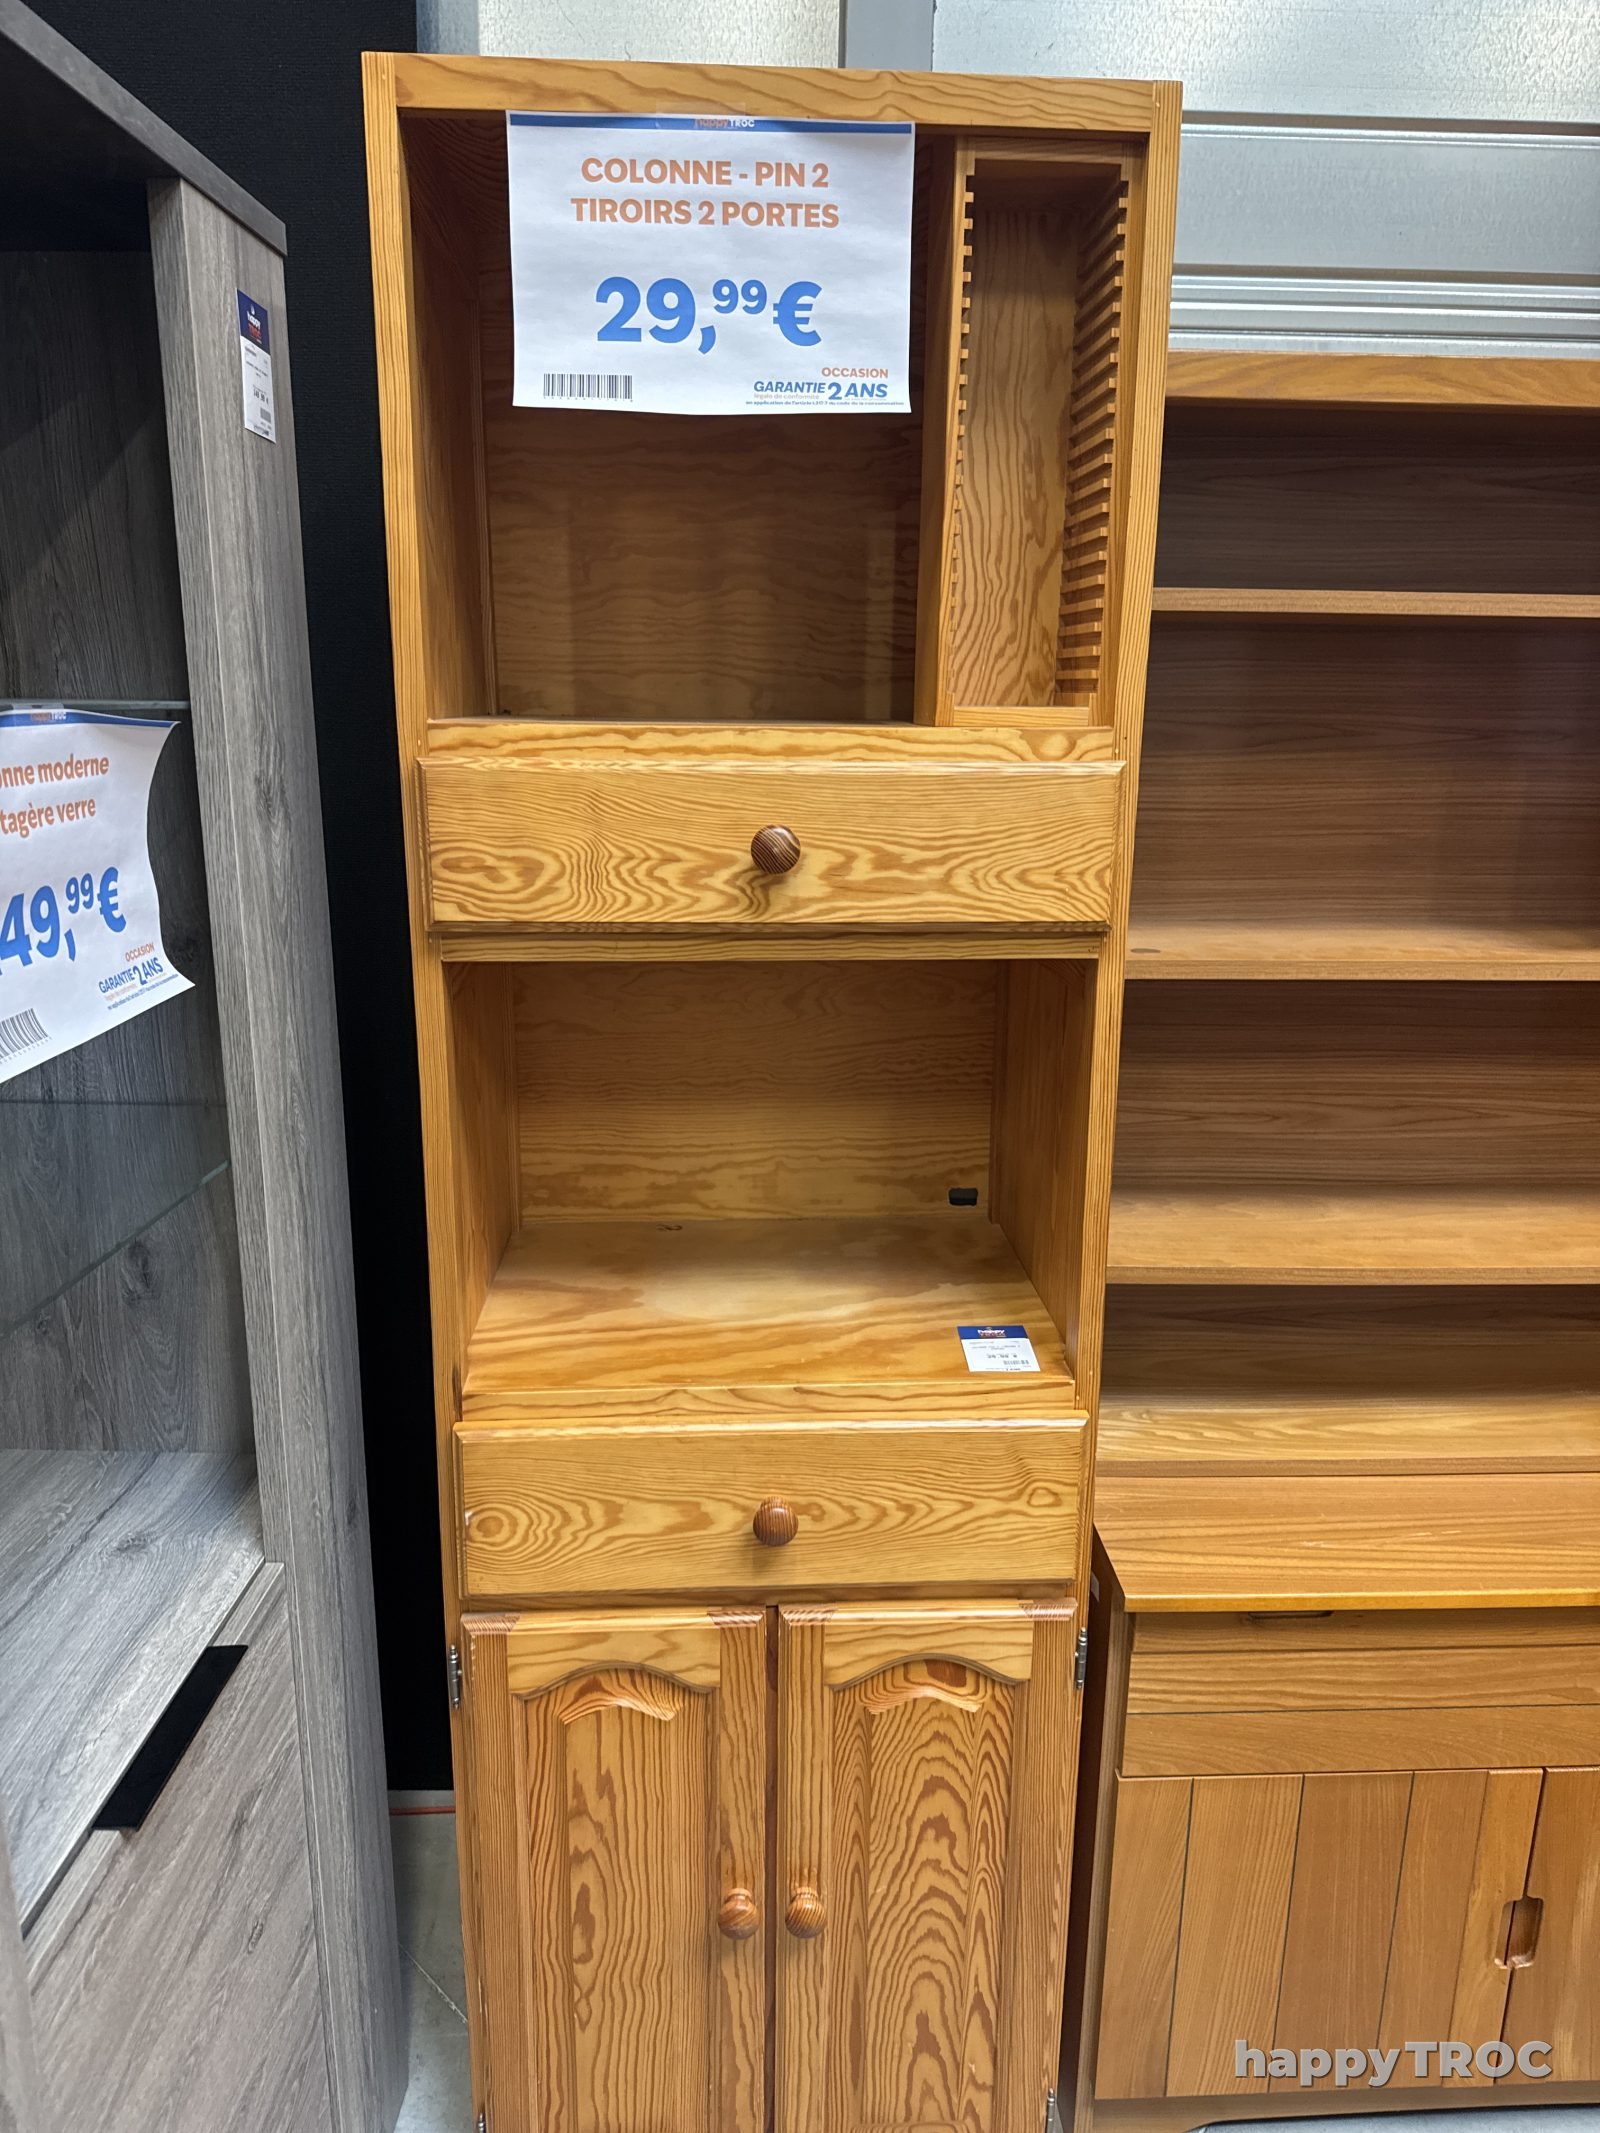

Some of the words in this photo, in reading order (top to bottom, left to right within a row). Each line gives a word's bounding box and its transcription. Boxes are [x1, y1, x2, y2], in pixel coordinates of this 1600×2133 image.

[581, 157, 732, 186] COLONNE
[754, 161, 805, 188] PIN
[811, 162, 830, 188] 2
[570, 197, 692, 226] TIROIRS
[698, 200, 715, 226] 2
[722, 201, 840, 229] PORTES
[821, 367, 889, 379] OCCASION
[753, 380, 826, 394] GARANTIE
[827, 381, 843, 401] 2
[844, 382, 888, 398] ANS
[38, 753, 110, 783] moderne
[56, 798, 97, 823] verre
[0, 866, 127, 970] 49,99€
[125, 942, 155, 962] OCCASION
[98, 967, 135, 993] GARANTIE
[132, 965, 148, 986] 2
[141, 957, 164, 979] ANS
